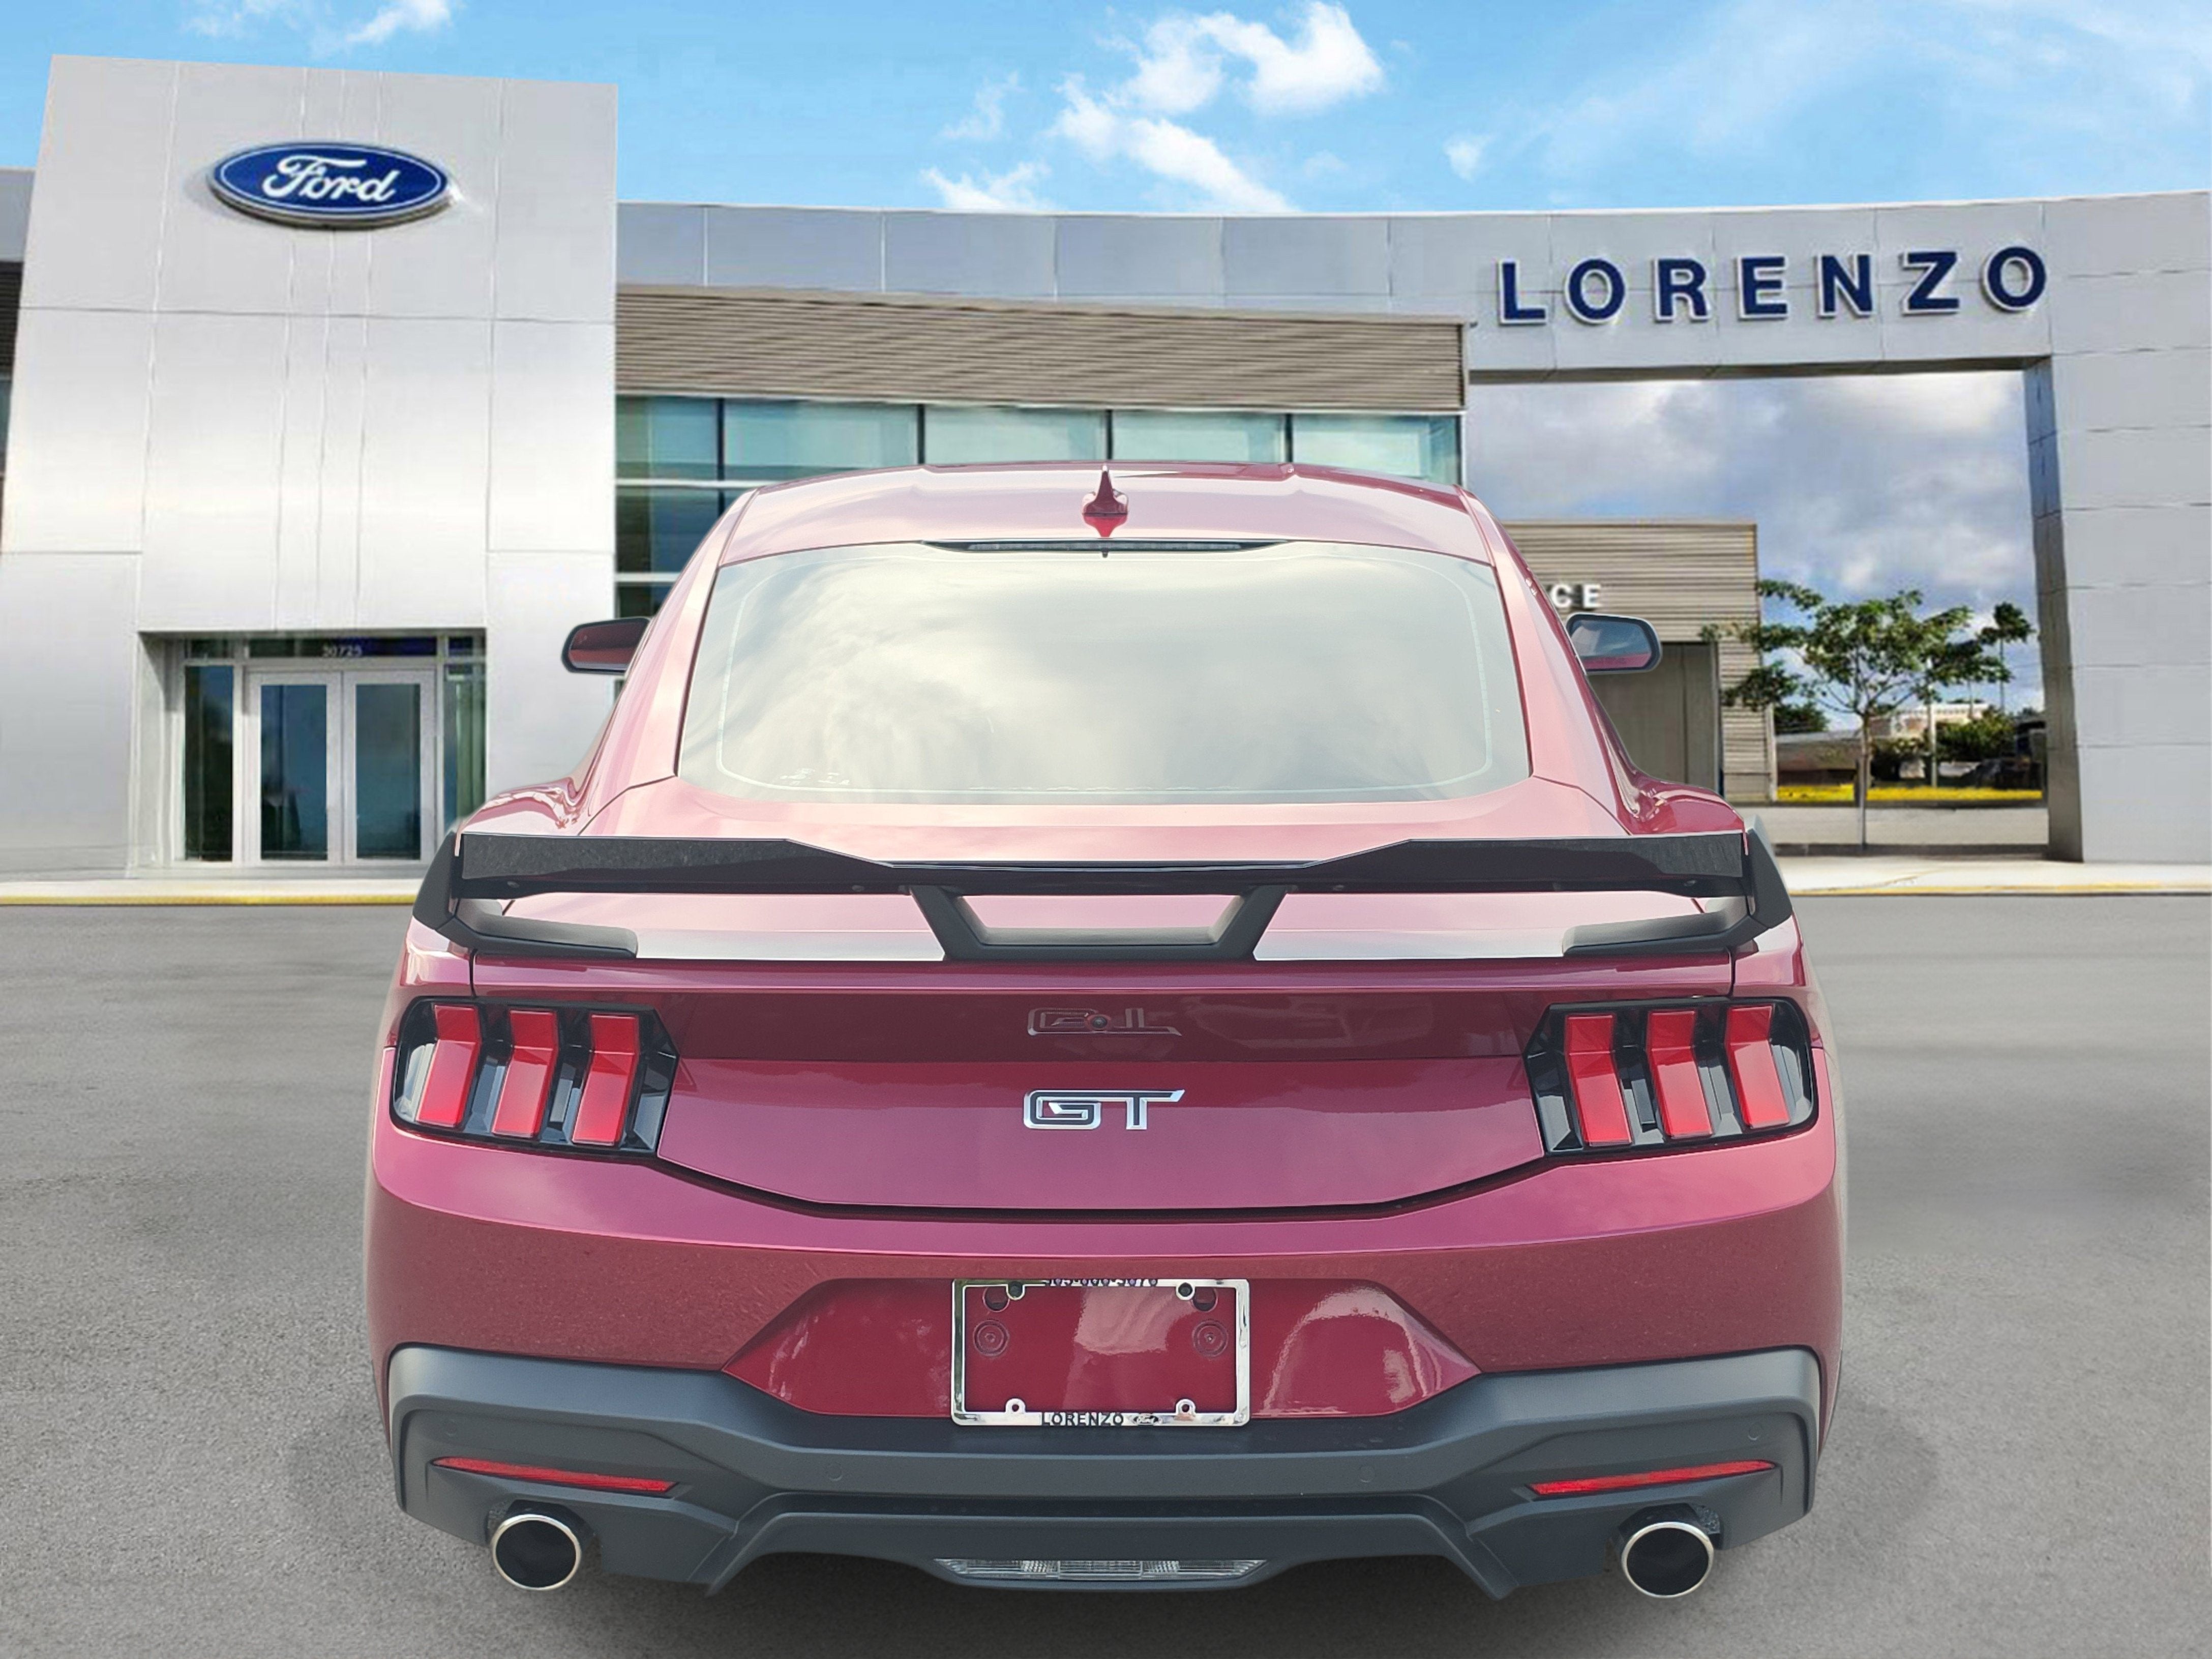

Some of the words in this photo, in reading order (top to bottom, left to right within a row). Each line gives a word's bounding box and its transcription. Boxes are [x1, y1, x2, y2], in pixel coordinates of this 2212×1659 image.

[262, 155, 400, 201] Ford
[1498, 246, 2047, 324] LORENZO
[1024, 1089, 1185, 1130] GT
[1042, 1411, 1124, 1426] LORENZO
